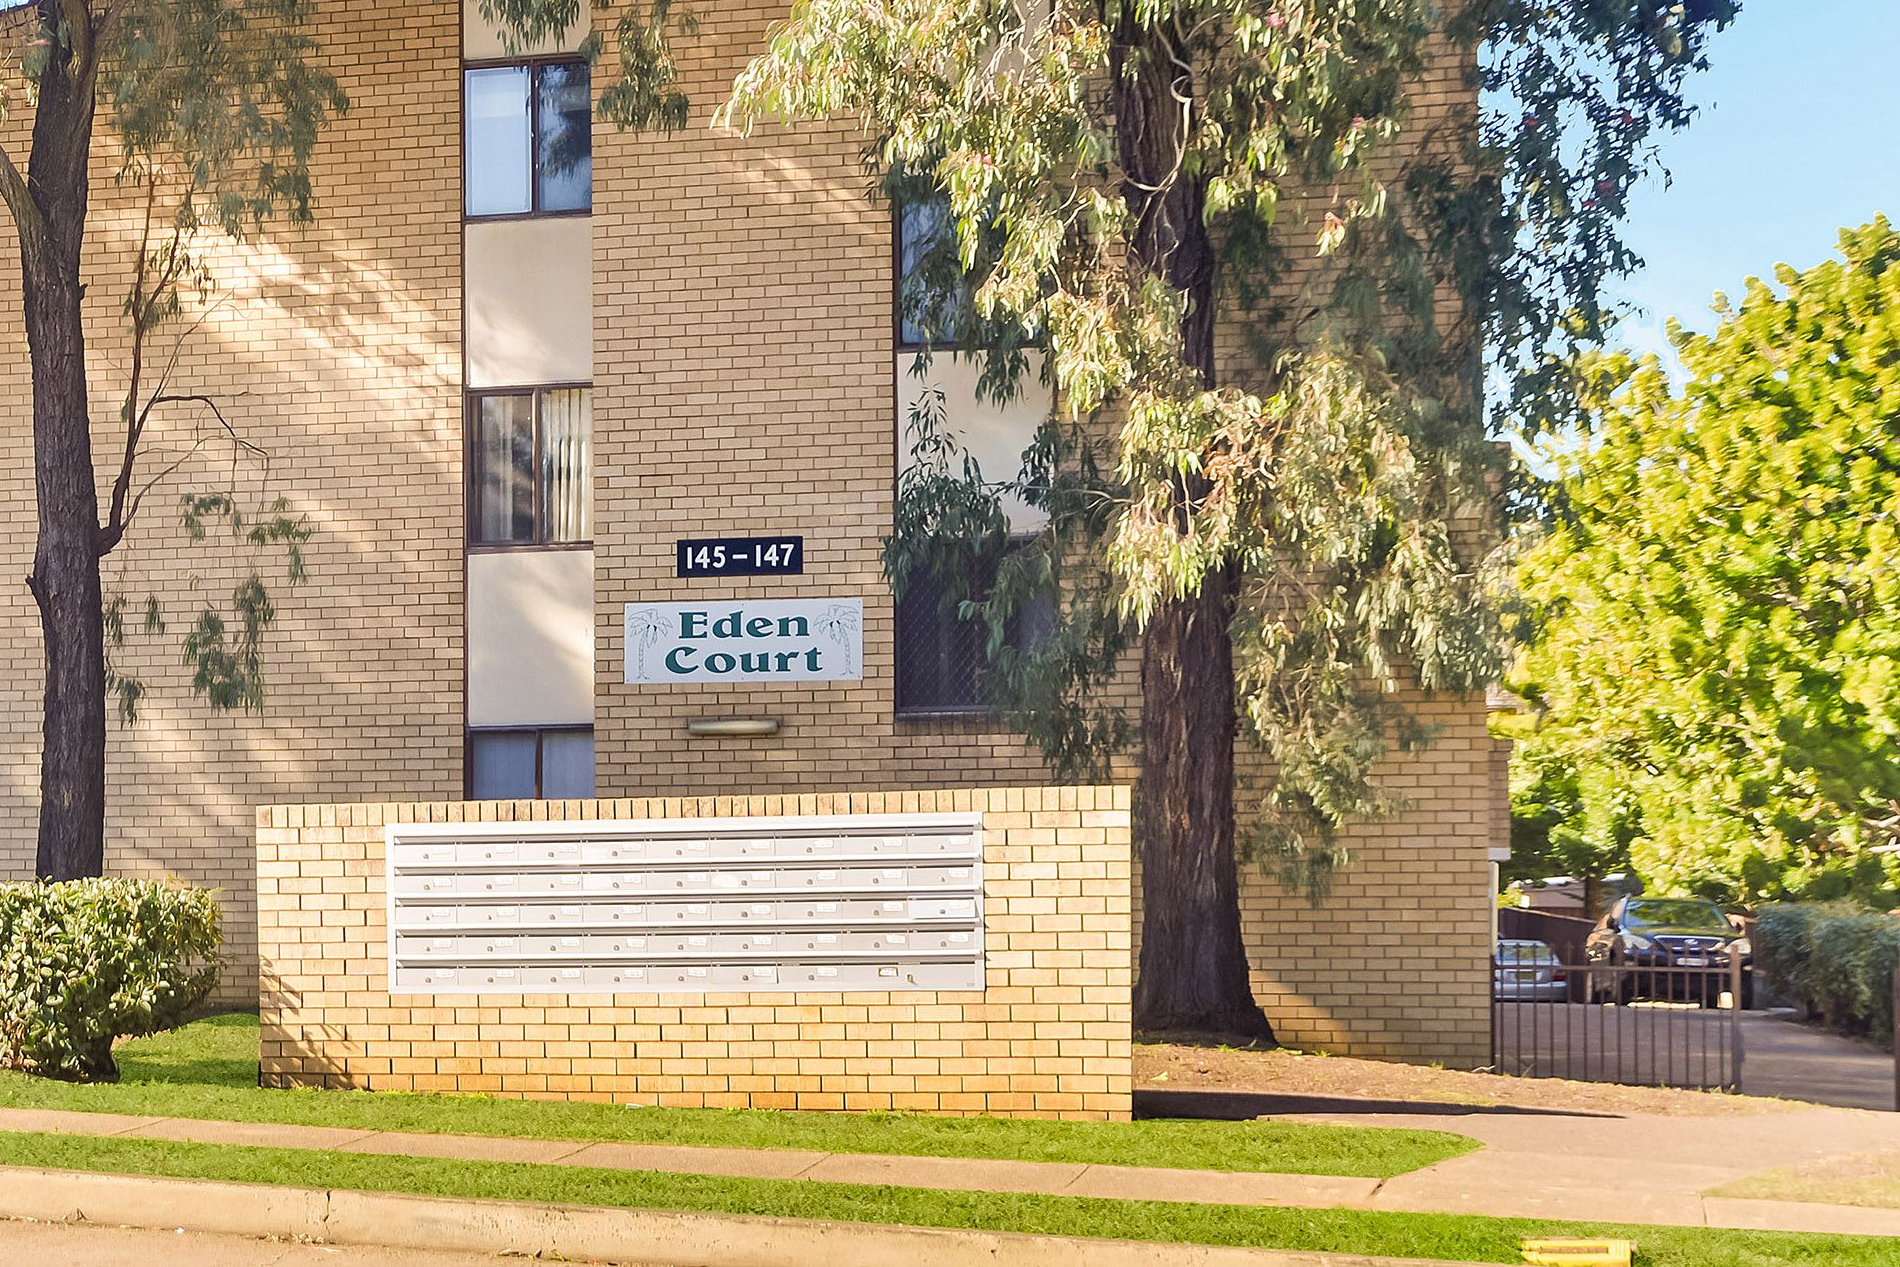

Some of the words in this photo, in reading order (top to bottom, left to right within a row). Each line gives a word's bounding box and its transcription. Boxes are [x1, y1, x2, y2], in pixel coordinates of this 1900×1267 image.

[686, 543, 795, 570] 145-147
[678, 609, 810, 640] Eden
[664, 645, 824, 675] Court
